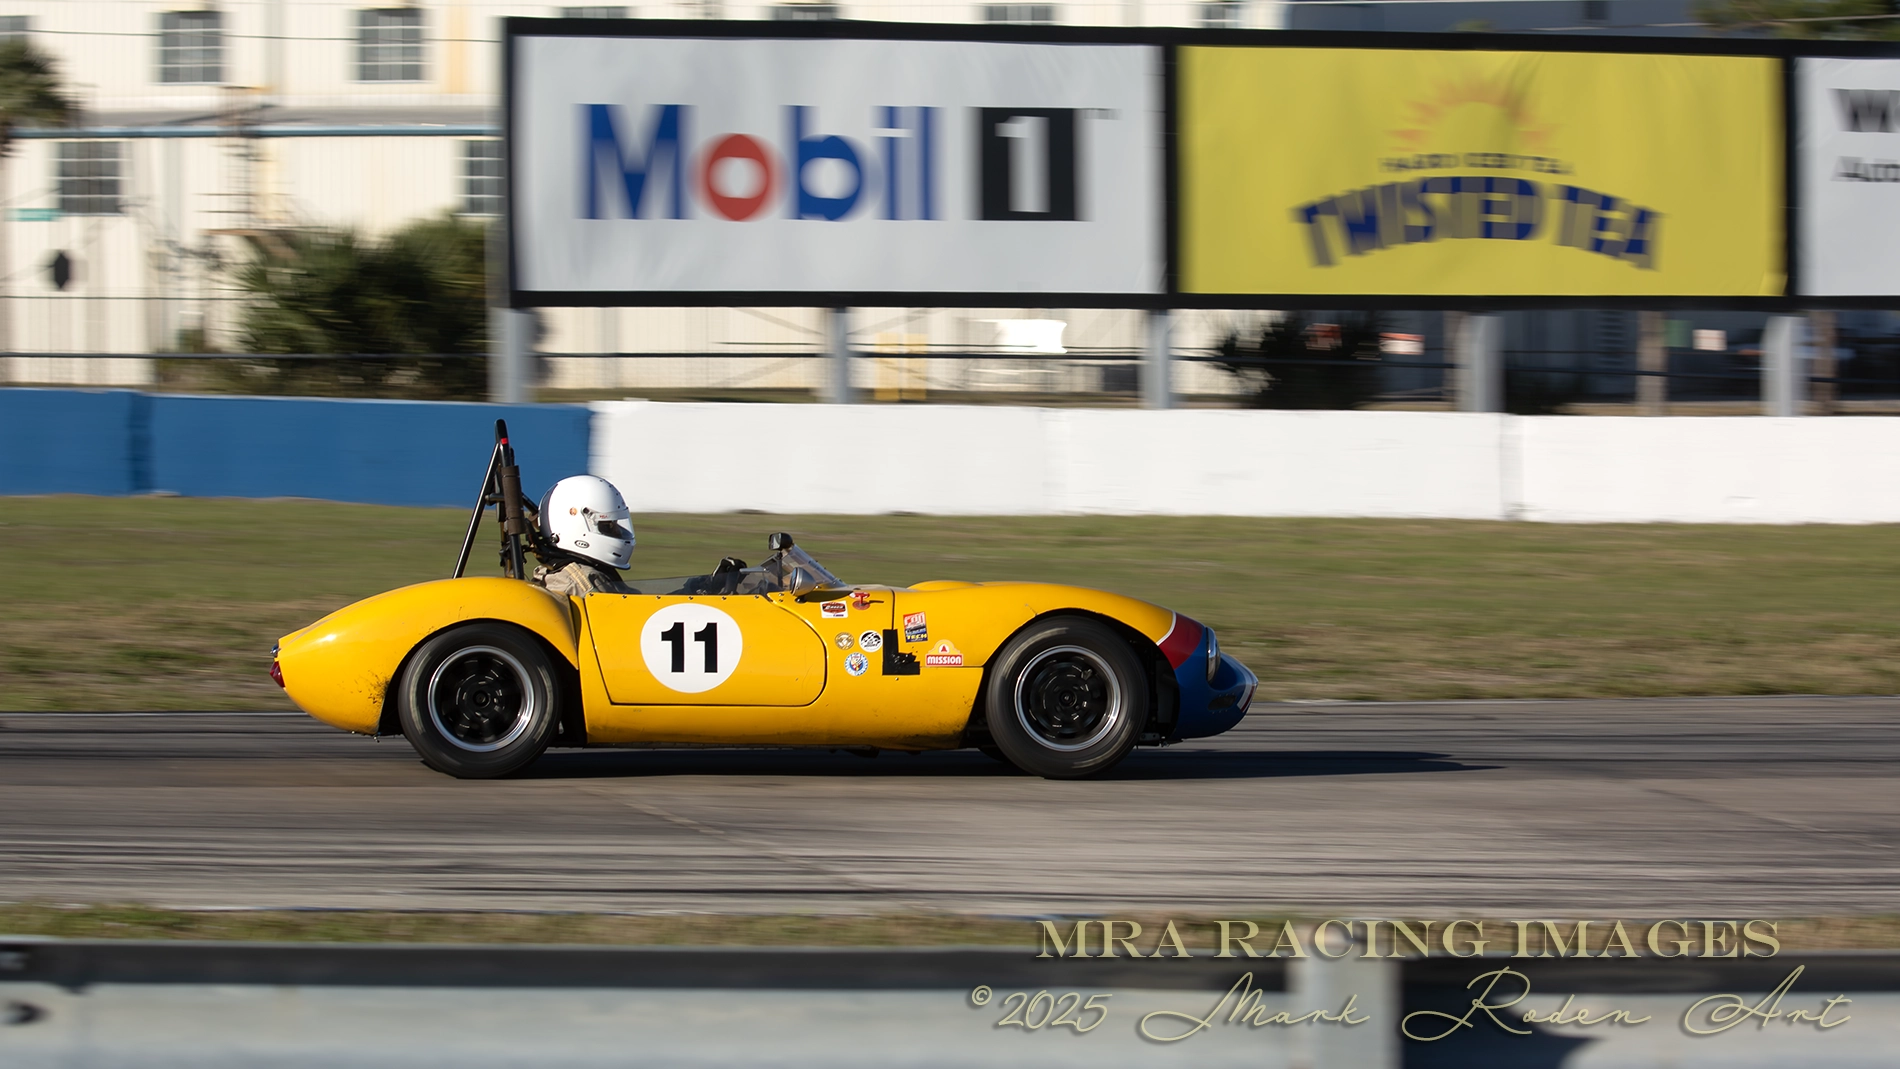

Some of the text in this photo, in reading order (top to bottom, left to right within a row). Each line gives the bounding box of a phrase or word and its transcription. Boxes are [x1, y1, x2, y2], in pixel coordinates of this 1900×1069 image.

[573, 103, 943, 222] Mobil
[1289, 176, 1666, 271] TWISTED TEA
[661, 622, 718, 673] 11
[927, 656, 962, 665] MISSION
